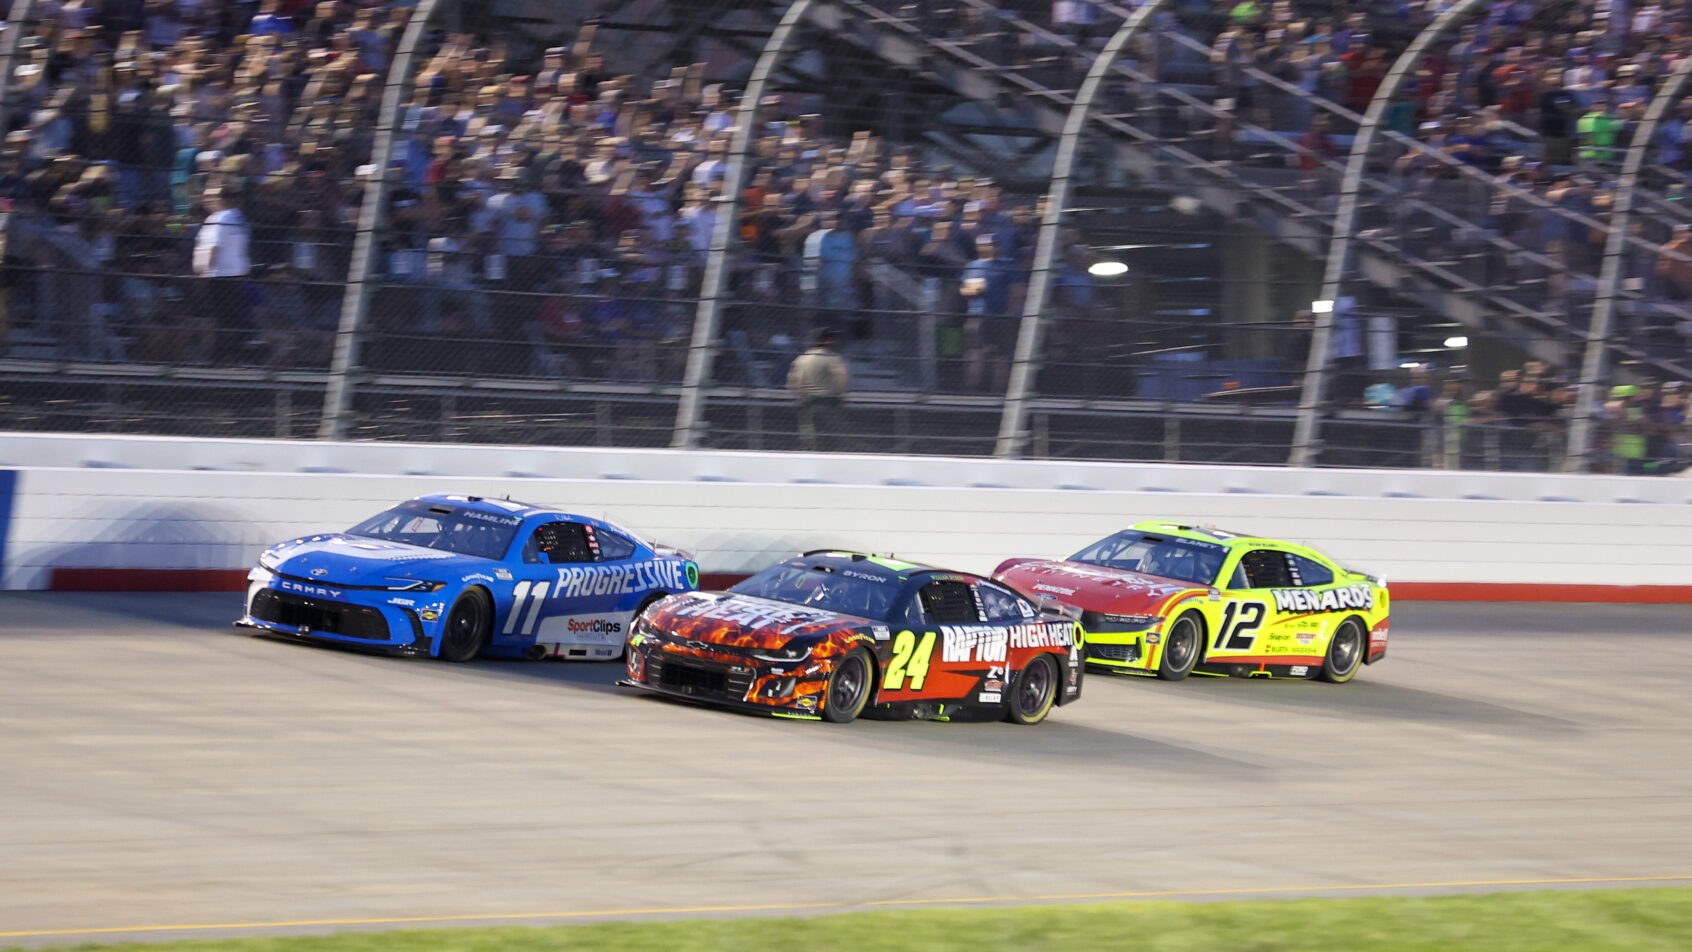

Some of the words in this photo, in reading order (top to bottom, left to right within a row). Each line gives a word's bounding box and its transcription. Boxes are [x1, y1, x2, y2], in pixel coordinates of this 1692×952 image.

[464, 511, 519, 526] HAMLIN
[1175, 537, 1218, 549] BLANEY
[281, 581, 342, 598] CAMRY
[553, 560, 685, 599] PROGRESSIVE
[843, 570, 887, 583] BYRON
[502, 580, 550, 635] 11
[1270, 588, 1374, 614] MENARDS
[1008, 623, 1049, 648] HIGH
[1048, 621, 1074, 647] HEAT
[1212, 600, 1267, 651] 12
[940, 625, 1009, 663] RAPTOR
[883, 630, 937, 691] 24
